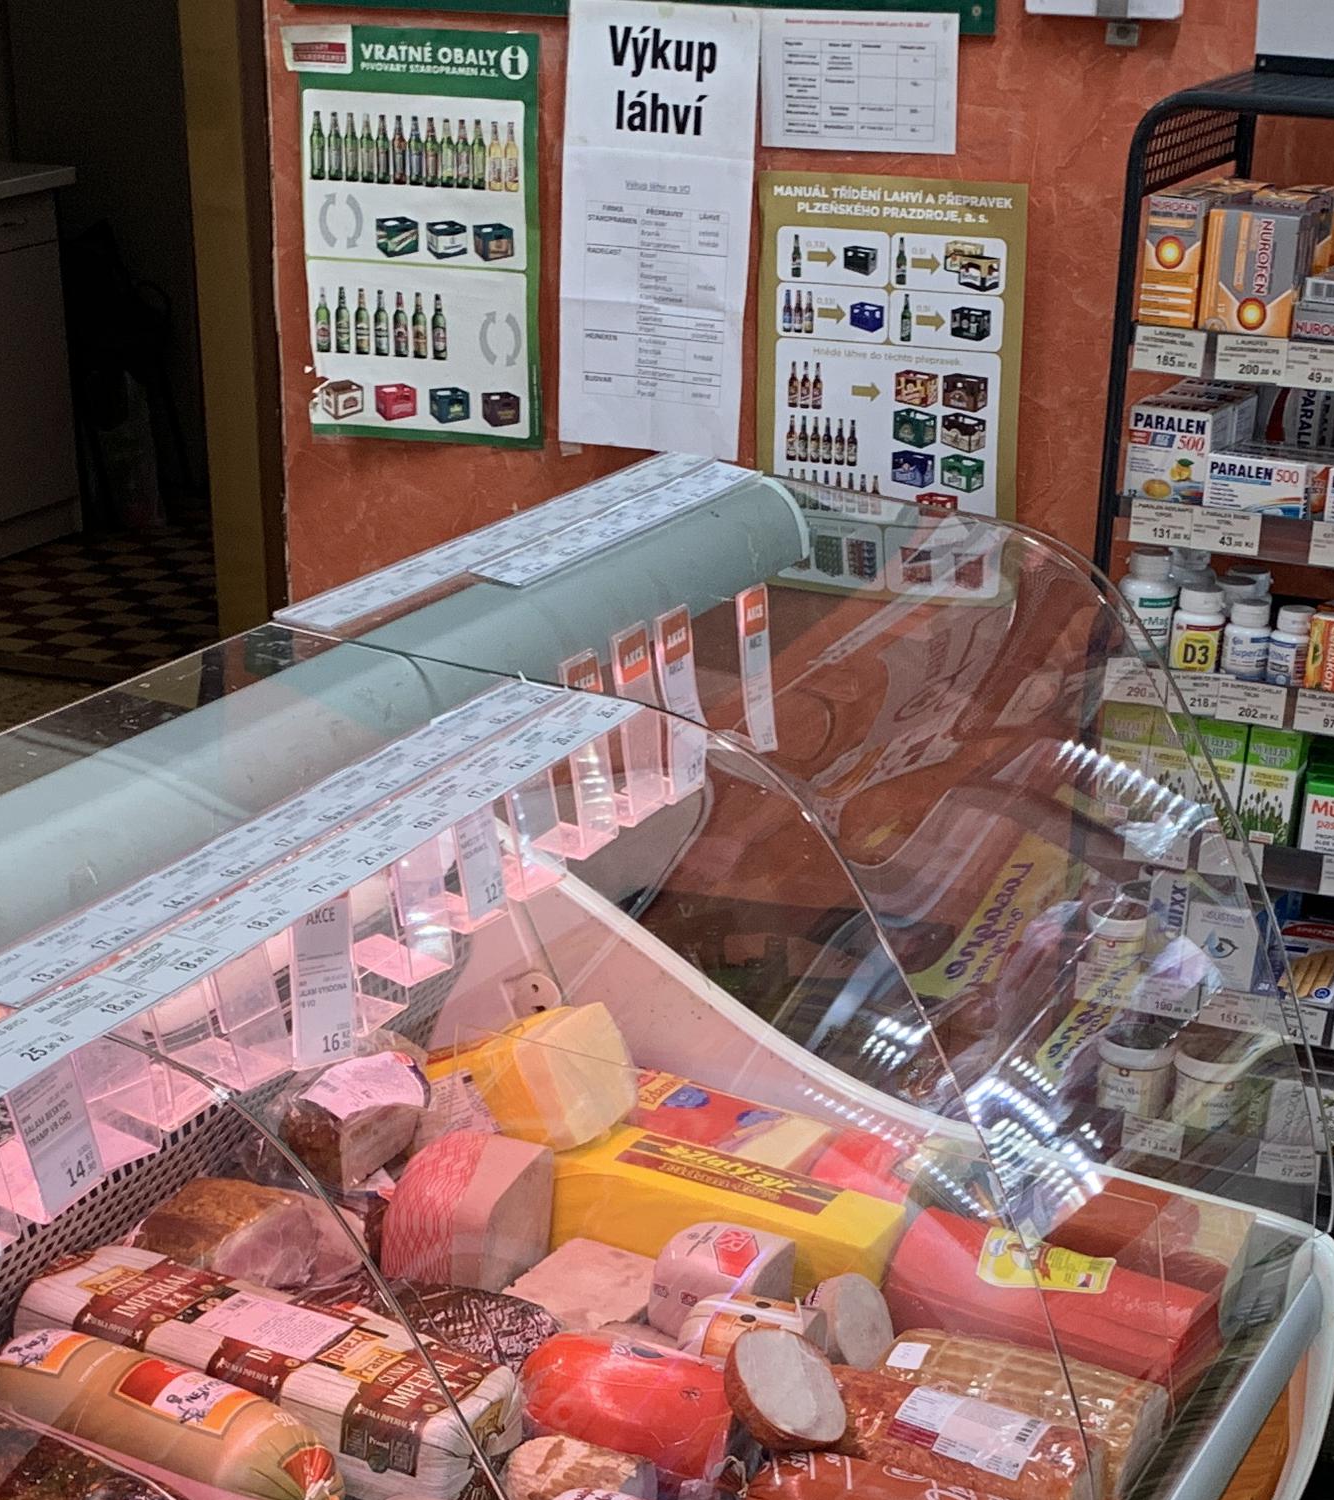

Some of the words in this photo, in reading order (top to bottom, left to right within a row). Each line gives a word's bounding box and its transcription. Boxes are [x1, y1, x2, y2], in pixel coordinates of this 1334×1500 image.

[359, 41, 432, 63] VRATNÉ
[437, 46, 499, 67] OBALY
[609, 25, 717, 82] Výkup
[616, 90, 704, 136] láhví
[773, 184, 829, 199] MANUÁL
[883, 189, 924, 204] LAHVÍ
[937, 194, 1013, 210] PŘEPRAVEK
[1150, 199, 1198, 213] NUROFEN
[797, 201, 881, 218] PLZEŇSKÉHO
[1252, 218, 1275, 295] NUROFEN
[1133, 411, 1208, 435] PARALEN
[1177, 436, 1205, 451] 500
[1210, 461, 1274, 481] PARALEN
[1275, 469, 1300, 484] 500
[1182, 643, 1210, 665] D3
[305, 906, 336, 927] AKCE
[322, 1032, 341, 1054] 16
[112, 1273, 197, 1319] IMPERIAL
